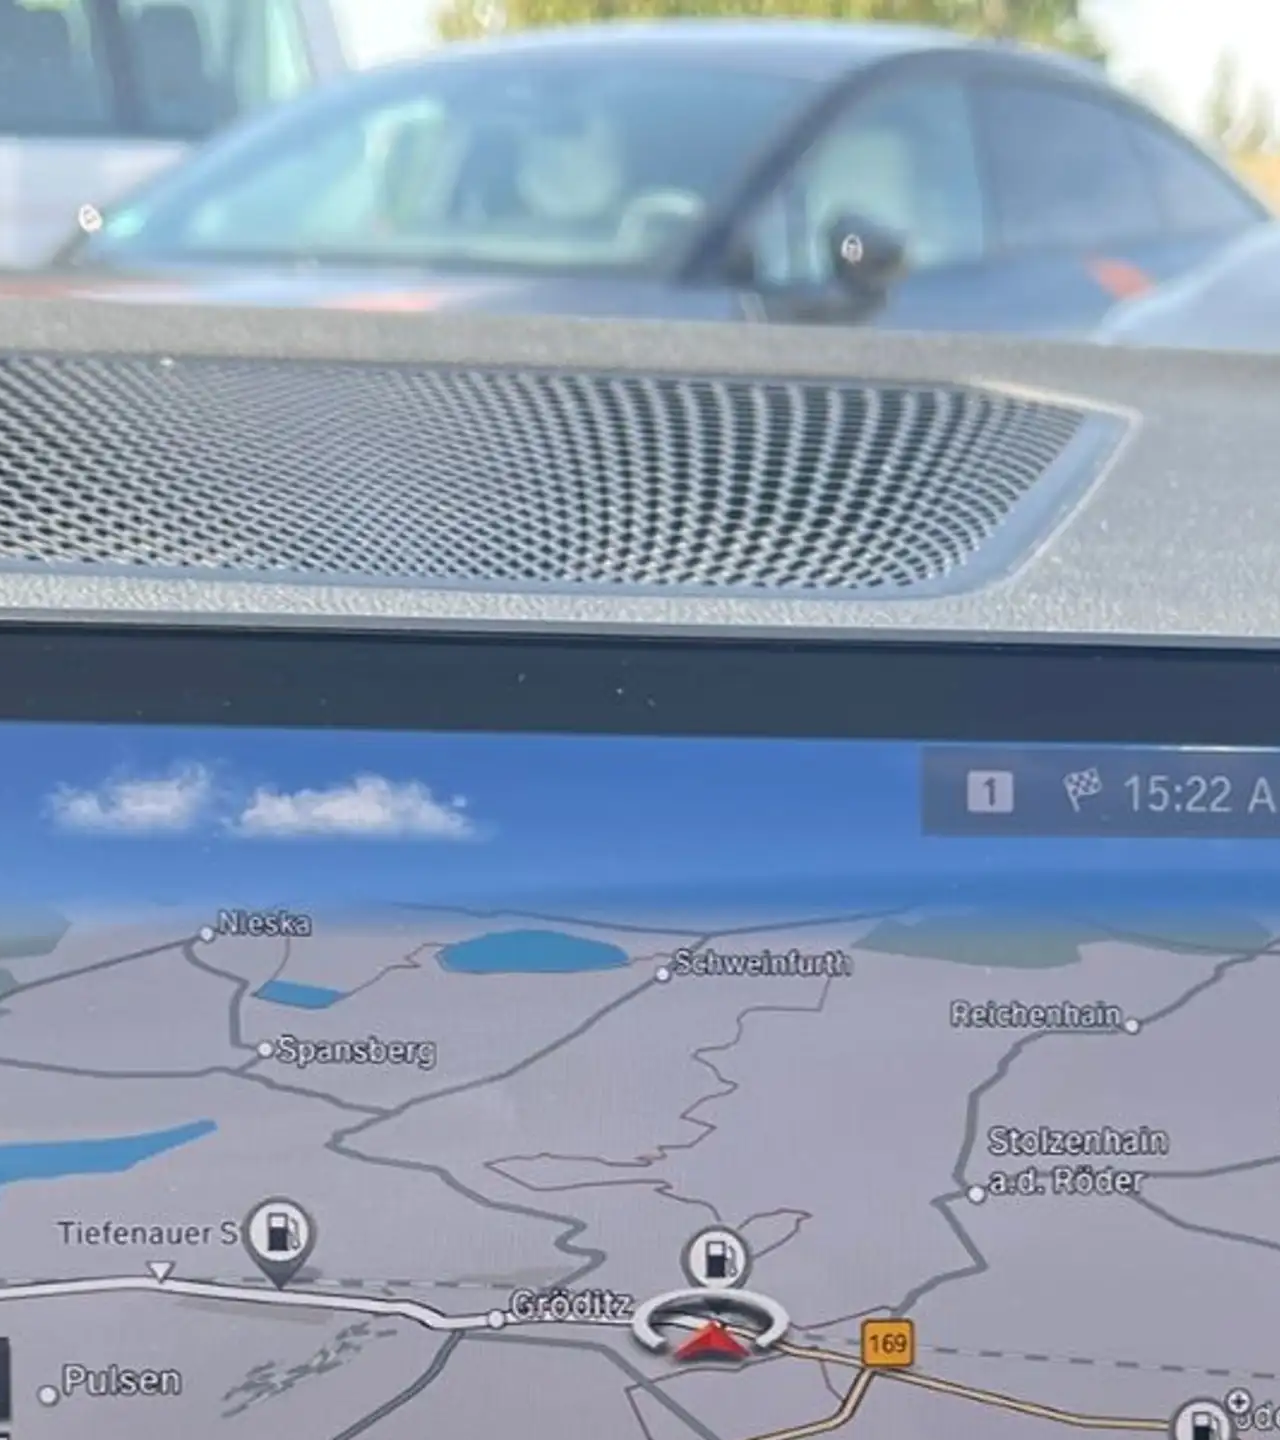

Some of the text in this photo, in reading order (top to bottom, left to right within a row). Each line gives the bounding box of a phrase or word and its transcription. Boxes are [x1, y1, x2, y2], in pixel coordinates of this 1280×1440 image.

[1124, 775, 1232, 813] 15:22
[1248, 776, 1276, 814] A
[675, 949, 853, 977] Schweinfurth
[950, 1000, 1121, 1028] Reichenhain
[276, 1036, 437, 1069] Spansberg
[988, 1126, 1169, 1156] Stolzenhain
[989, 1166, 1146, 1195] a.d. Röder
[57, 1220, 212, 1246] Tiefenauer
[510, 1288, 632, 1320] Gröditz
[869, 1334, 908, 1353] 169
[62, 1364, 182, 1396] Pulsen
